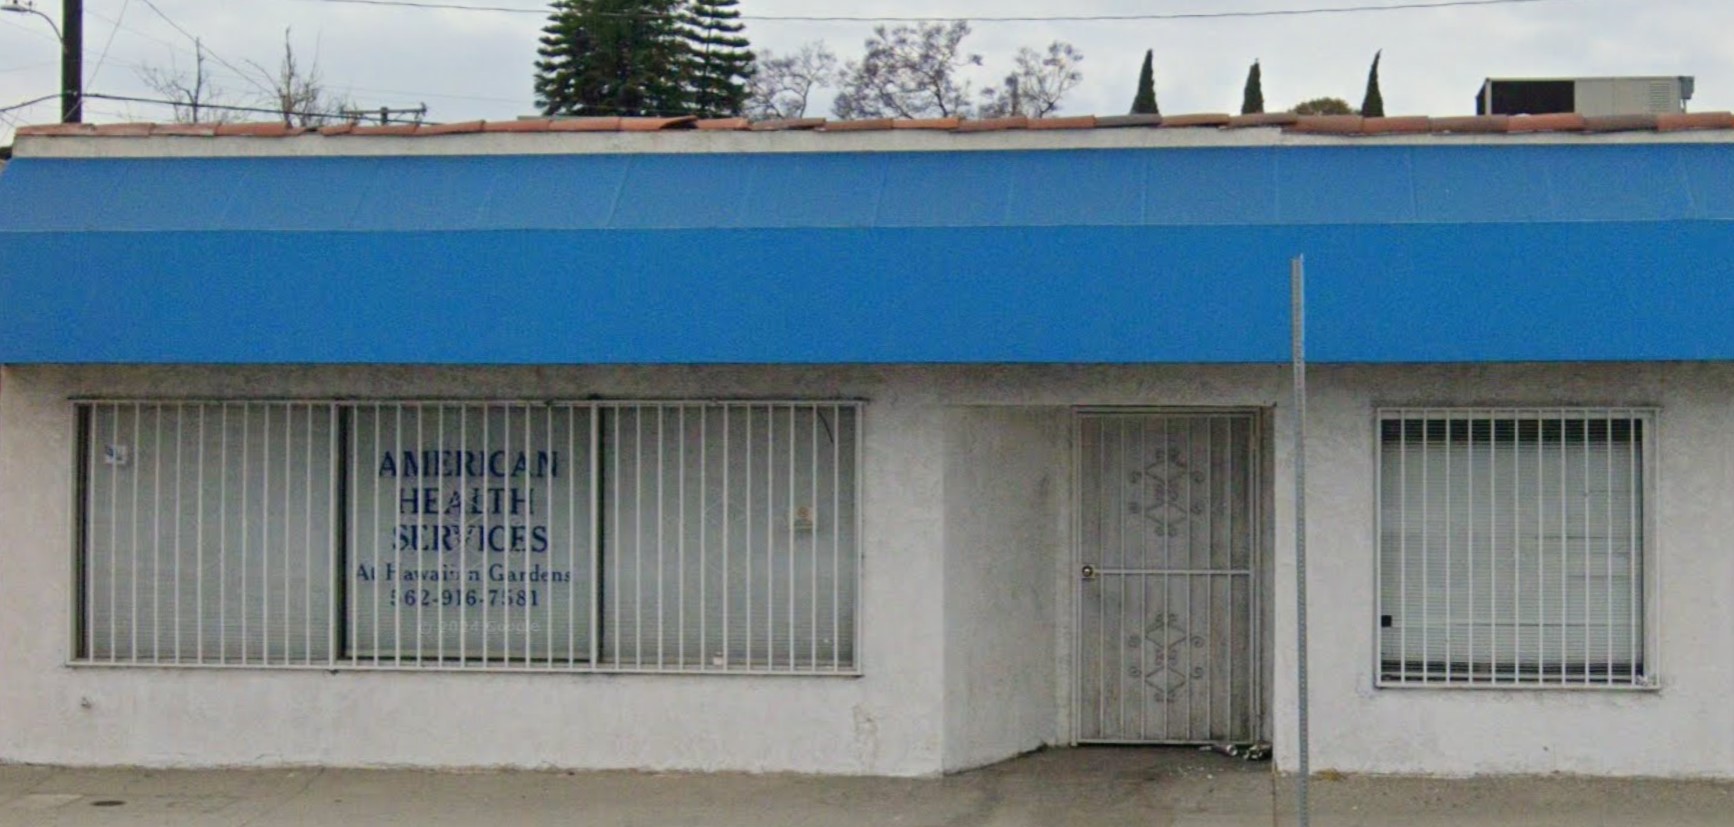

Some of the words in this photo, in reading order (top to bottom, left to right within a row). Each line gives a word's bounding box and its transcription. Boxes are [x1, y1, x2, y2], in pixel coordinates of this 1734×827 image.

[379, 450, 559, 478] AMERICAN
[399, 487, 535, 515] HEALTH
[392, 523, 549, 552] SERVICES
[356, 563, 377, 581] At
[488, 562, 571, 583] Gardens
